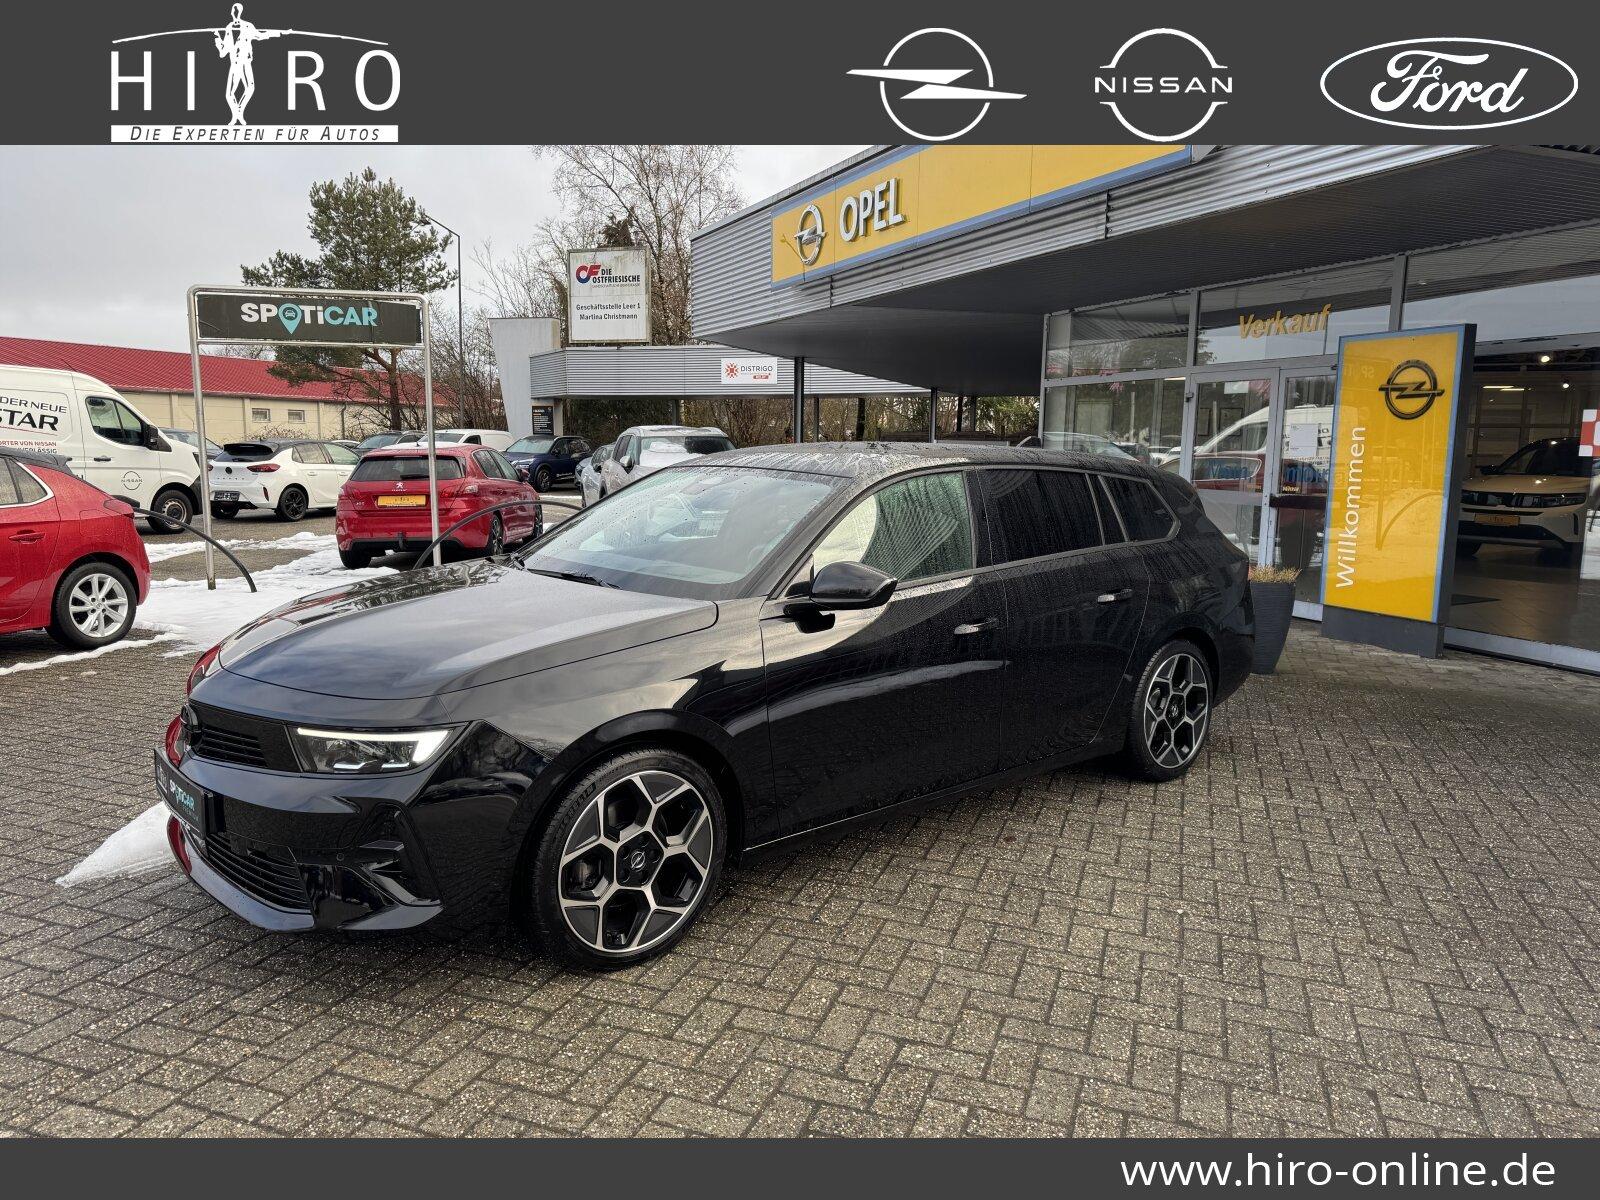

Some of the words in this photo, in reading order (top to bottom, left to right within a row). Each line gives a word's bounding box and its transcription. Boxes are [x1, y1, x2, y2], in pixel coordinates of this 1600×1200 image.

[840, 178, 905, 242] OPEL
[592, 275, 641, 284] OSTFRIESISCHE
[601, 268, 612, 276] DIE
[576, 303, 622, 311] Geschäftsstelle
[1239, 303, 1332, 339] Verkauf
[0, 396, 28, 408] DER
[30, 401, 67, 413] NEUE
[0, 408, 58, 431] TAR
[1335, 427, 1366, 588] Willkommen
